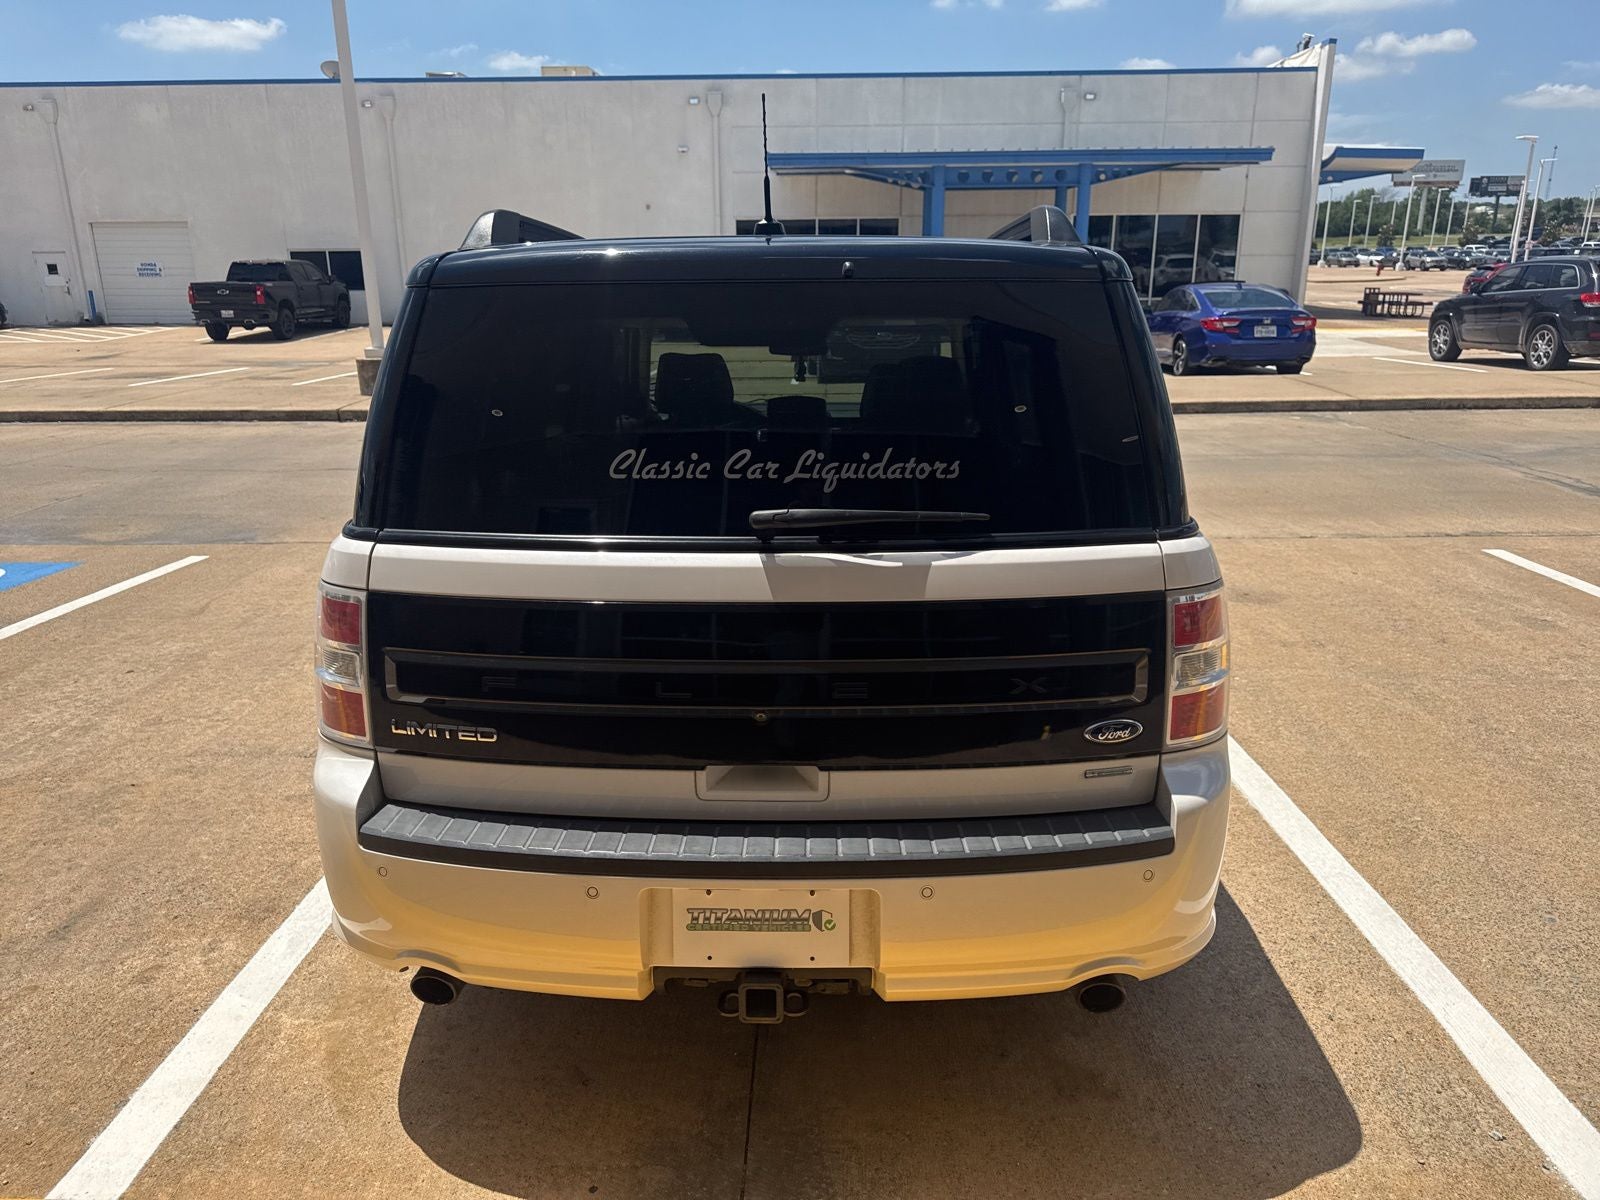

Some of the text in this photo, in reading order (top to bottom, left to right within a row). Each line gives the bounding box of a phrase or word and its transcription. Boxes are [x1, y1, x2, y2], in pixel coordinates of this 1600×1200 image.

[609, 447, 961, 494] Classic Car Liquidators
[391, 719, 498, 743] LIMITED
[1098, 723, 1131, 740] Ford
[686, 908, 811, 925] TITANIUM
